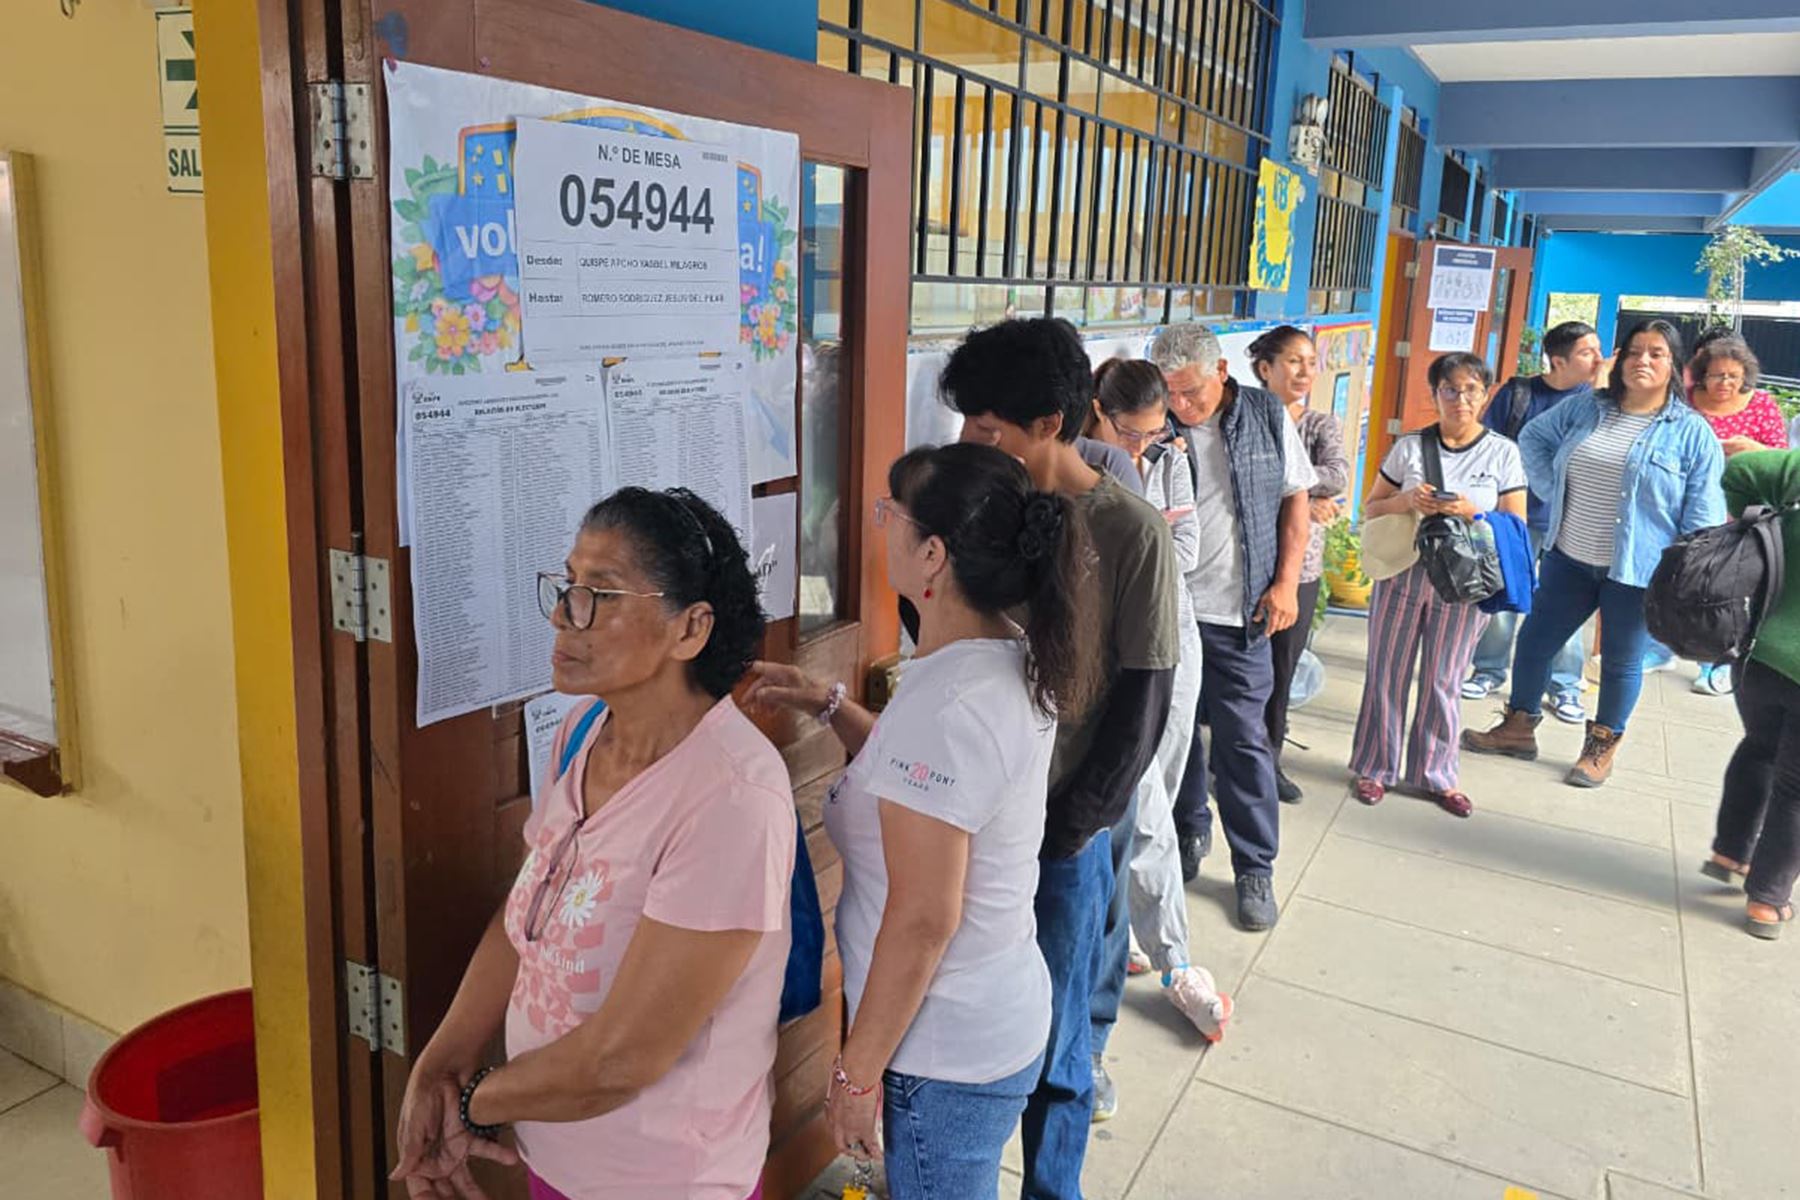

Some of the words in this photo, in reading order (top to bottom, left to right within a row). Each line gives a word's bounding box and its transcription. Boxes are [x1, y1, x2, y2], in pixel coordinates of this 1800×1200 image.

[168, 148, 202, 177] SAL
[622, 147, 641, 164] DE
[644, 150, 682, 170] MESA
[560, 173, 715, 235] 054944
[526, 254, 563, 267] Desde:
[740, 235, 764, 273] a!
[528, 292, 563, 304] Hasta:
[581, 293, 618, 303] ROMERO
